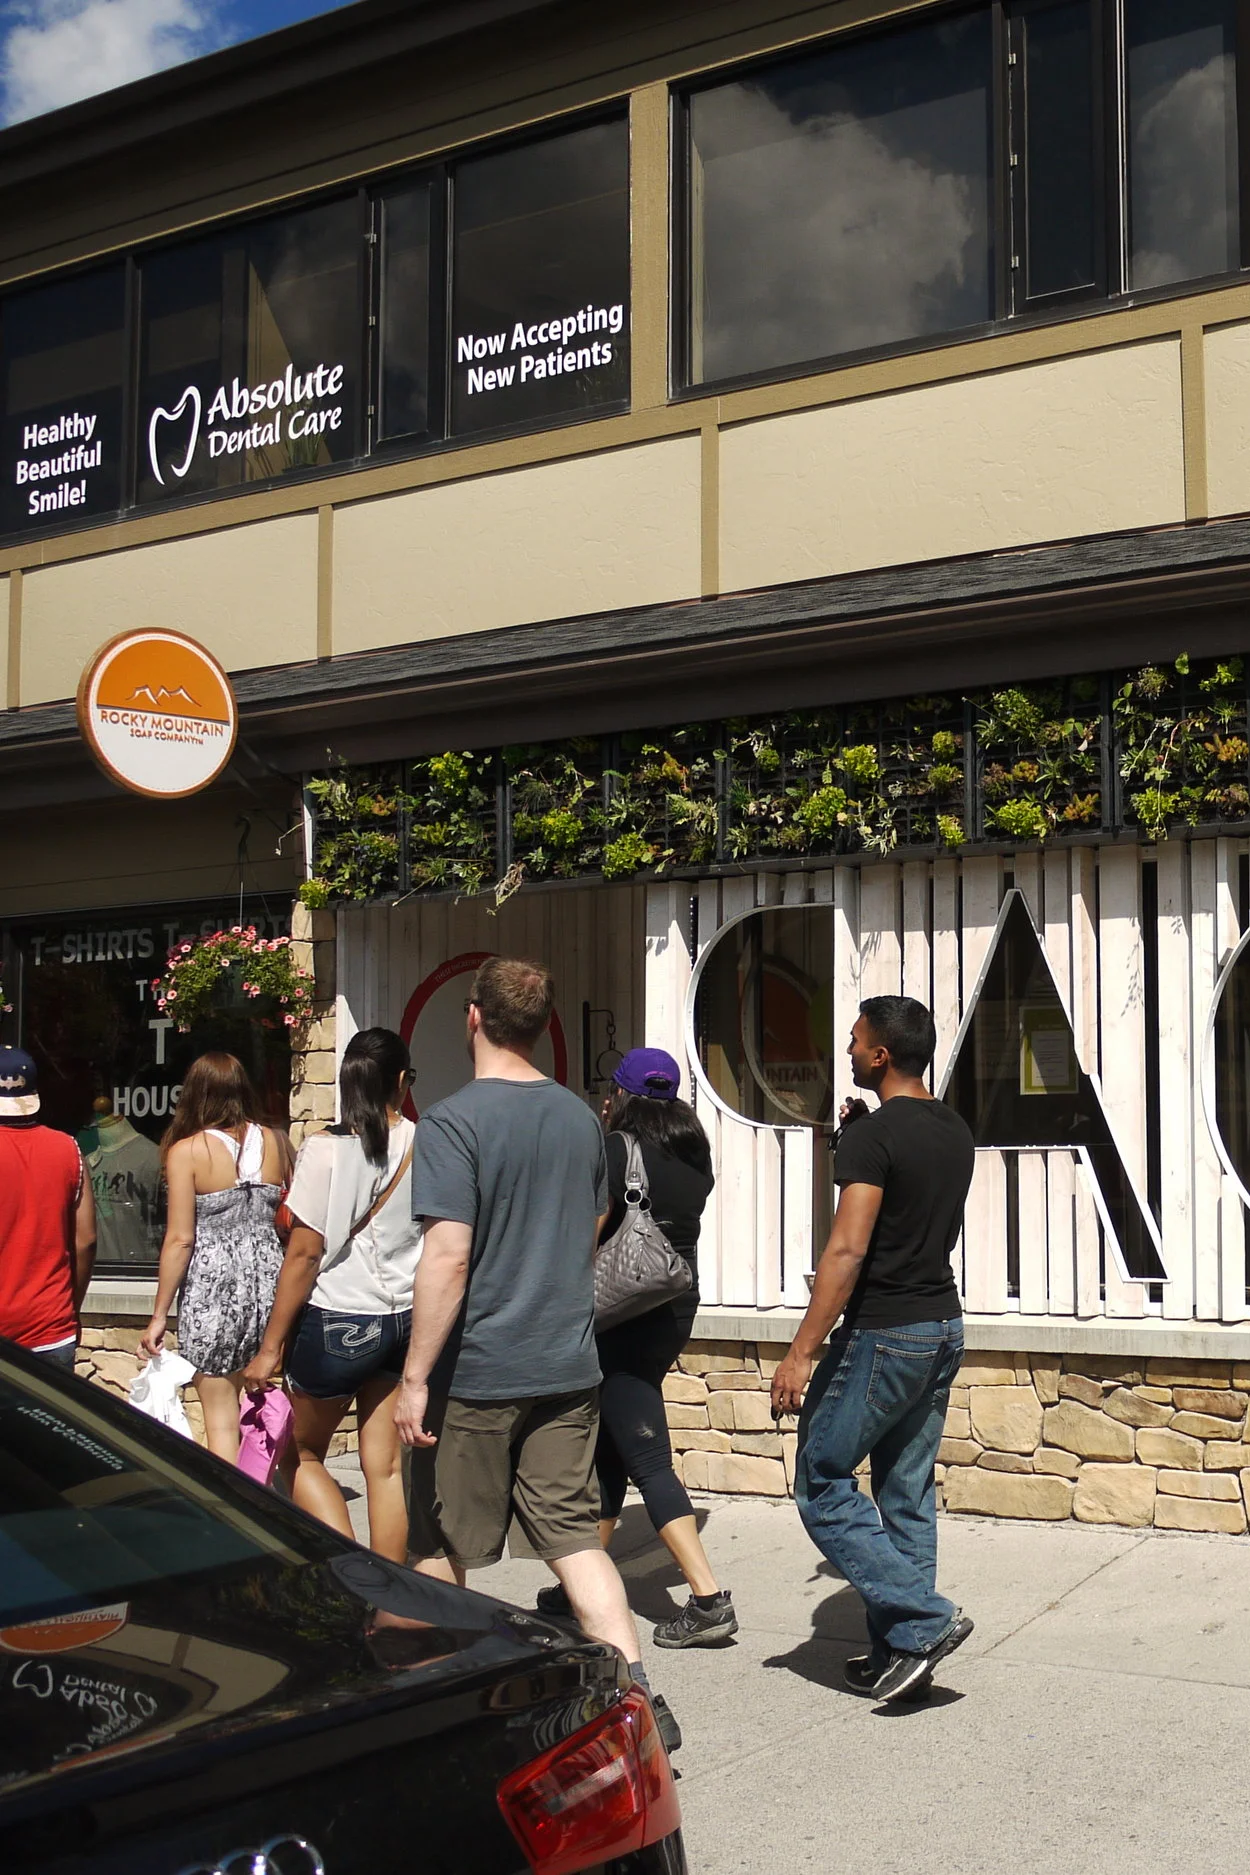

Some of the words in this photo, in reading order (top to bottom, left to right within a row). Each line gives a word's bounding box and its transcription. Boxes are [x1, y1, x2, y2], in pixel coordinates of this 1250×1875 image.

[457, 333, 507, 363] Now
[510, 304, 623, 351] Accepting
[467, 365, 516, 395] New
[520, 341, 612, 383] Patients
[207, 363, 344, 426] Absolute
[23, 411, 97, 449] Healthy
[207, 410, 281, 458] Dental
[288, 406, 342, 440] Care
[16, 441, 102, 485] Beautiful
[28, 480, 86, 515] Smile!
[100, 710, 148, 728] ROCKY
[151, 718, 224, 737] MOUNTAIN
[130, 728, 153, 739] SOAP
[30, 928, 154, 966] T-SHIRTS
[148, 1018, 174, 1065] T
[113, 1085, 184, 1117] HOUS
